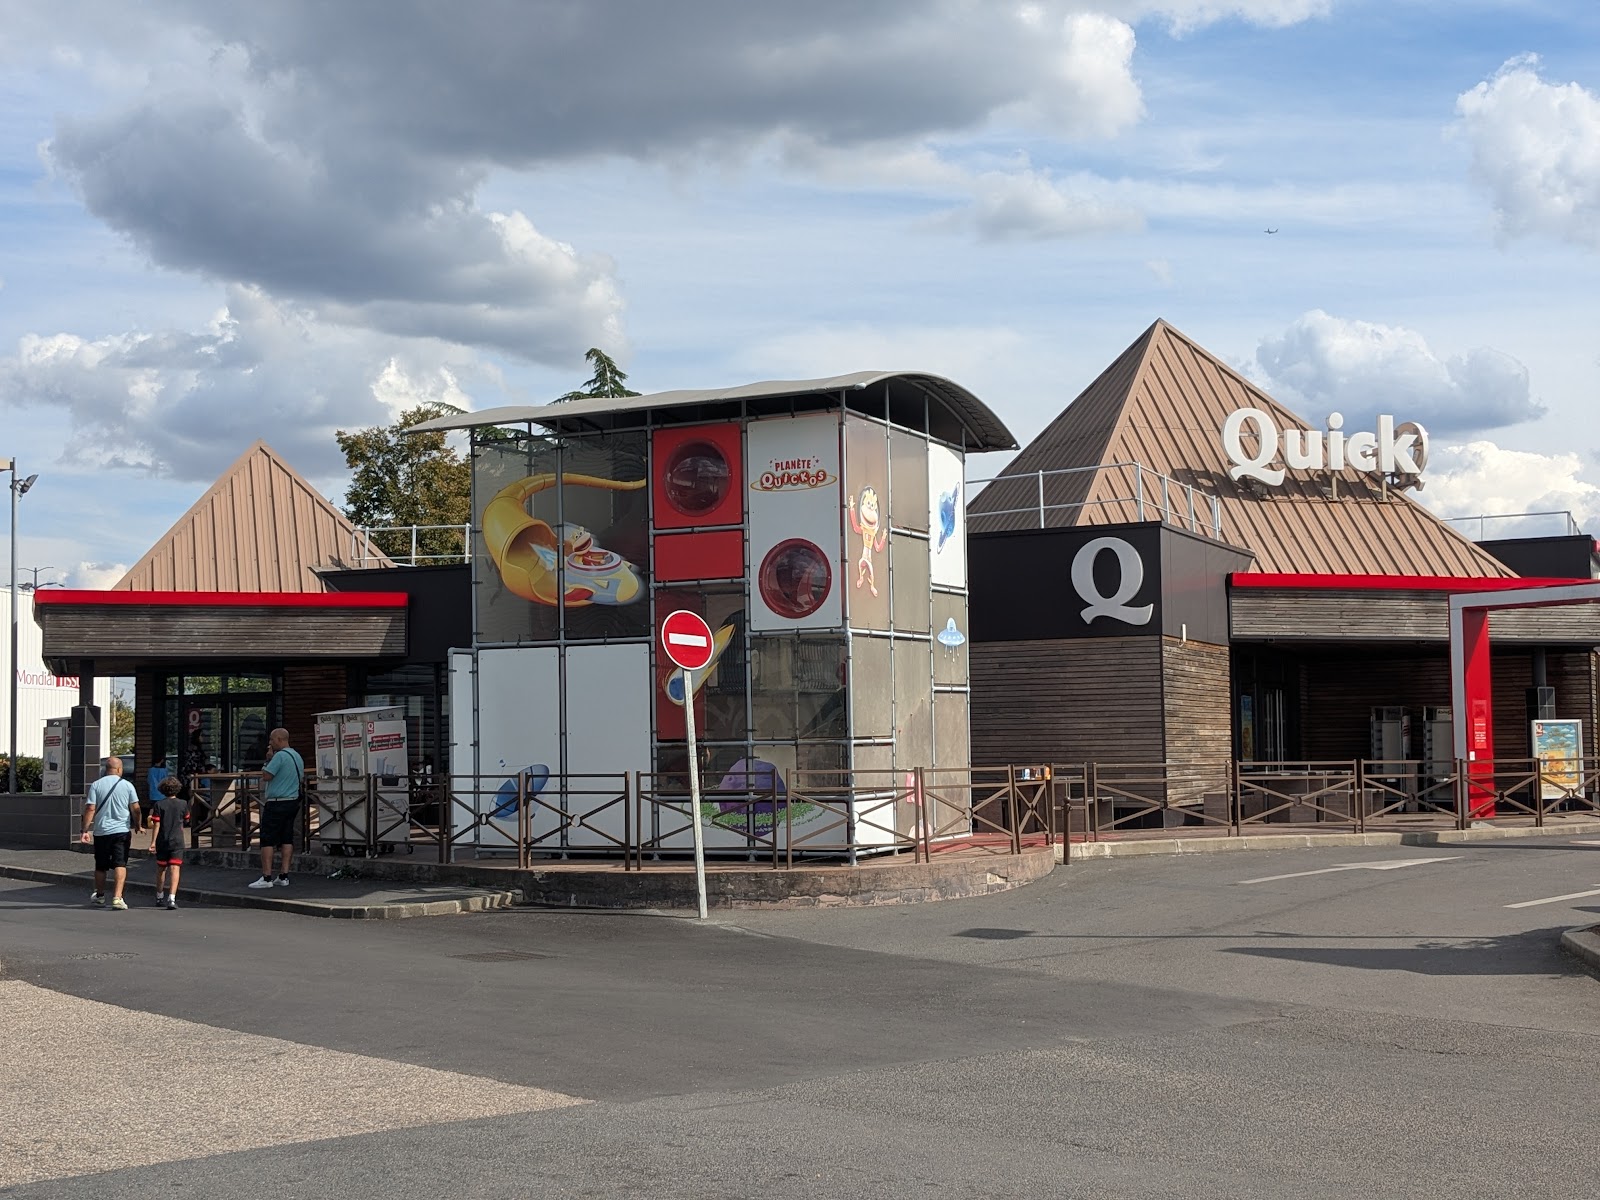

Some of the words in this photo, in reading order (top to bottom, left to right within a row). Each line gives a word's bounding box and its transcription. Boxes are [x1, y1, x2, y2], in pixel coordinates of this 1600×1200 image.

[774, 458, 812, 472] PLANÈTE
[1221, 407, 1422, 487] Quick
[1070, 536, 1154, 626] Q
